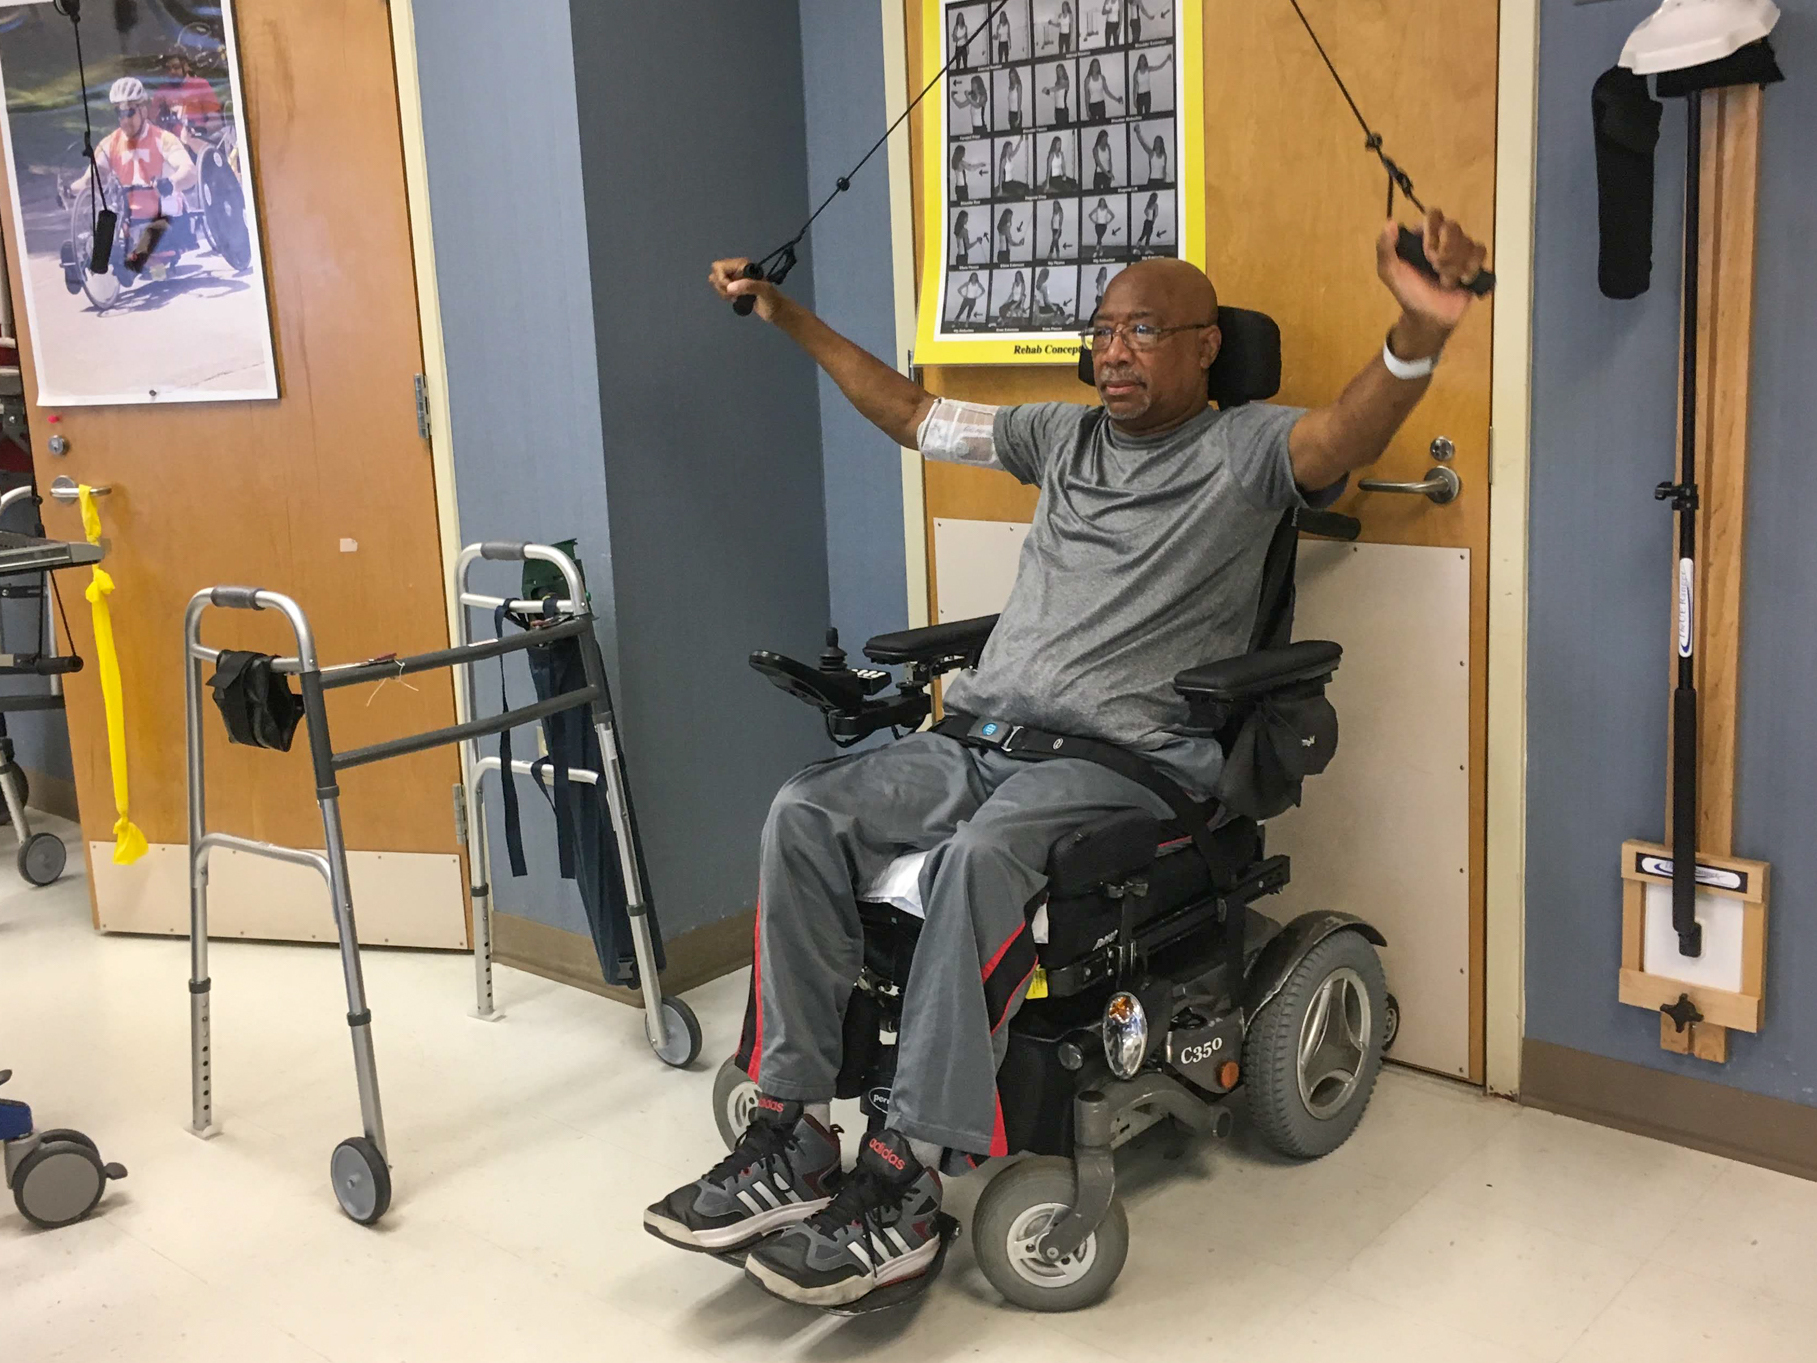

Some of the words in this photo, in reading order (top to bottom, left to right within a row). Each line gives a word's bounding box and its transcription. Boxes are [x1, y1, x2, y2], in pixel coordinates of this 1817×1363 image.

[1013, 344, 1042, 355] Rehab
[1180, 1037, 1223, 1064] C350
[868, 1137, 906, 1170] adidas
